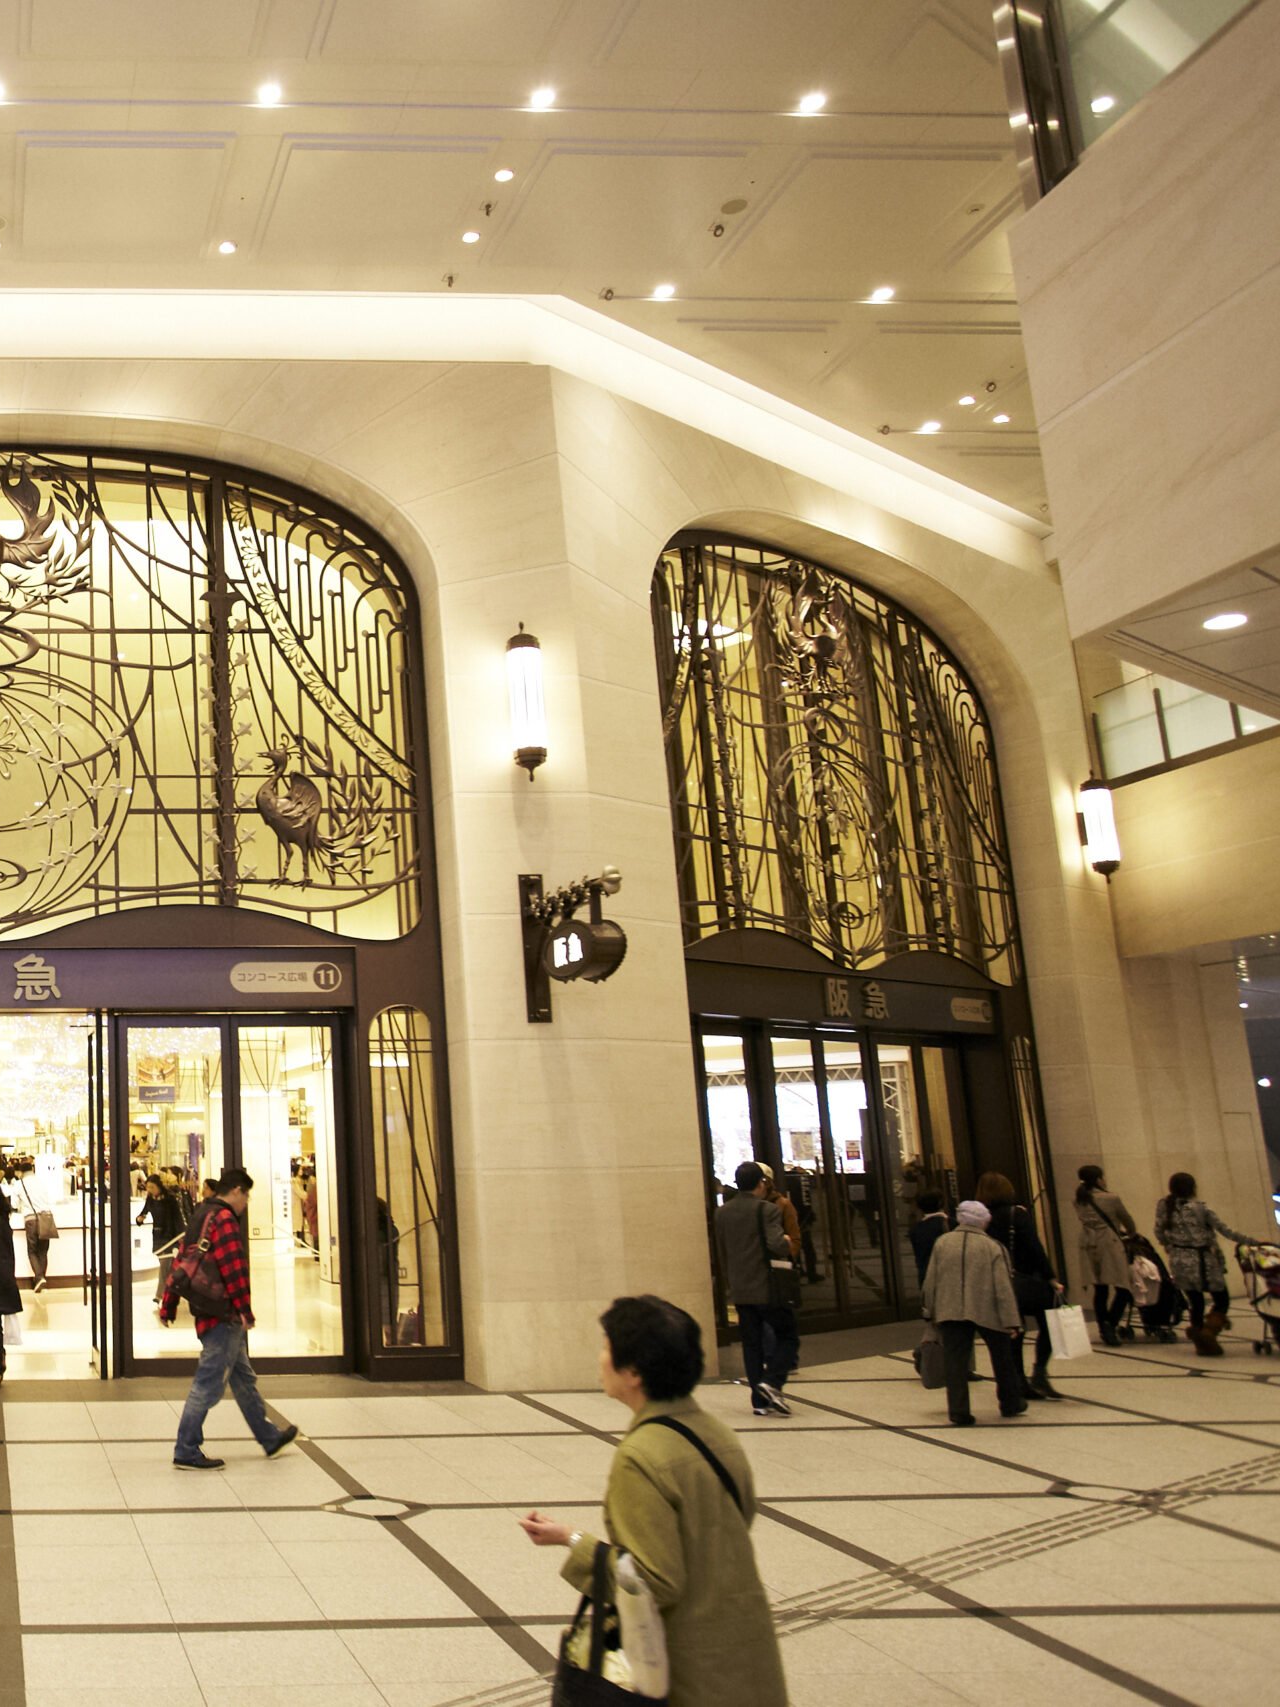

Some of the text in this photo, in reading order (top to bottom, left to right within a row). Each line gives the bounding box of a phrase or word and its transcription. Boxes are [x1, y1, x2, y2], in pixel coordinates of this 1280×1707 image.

[237, 969, 335, 985] コンコース広場 11
[825, 977, 891, 1020] 阪急
